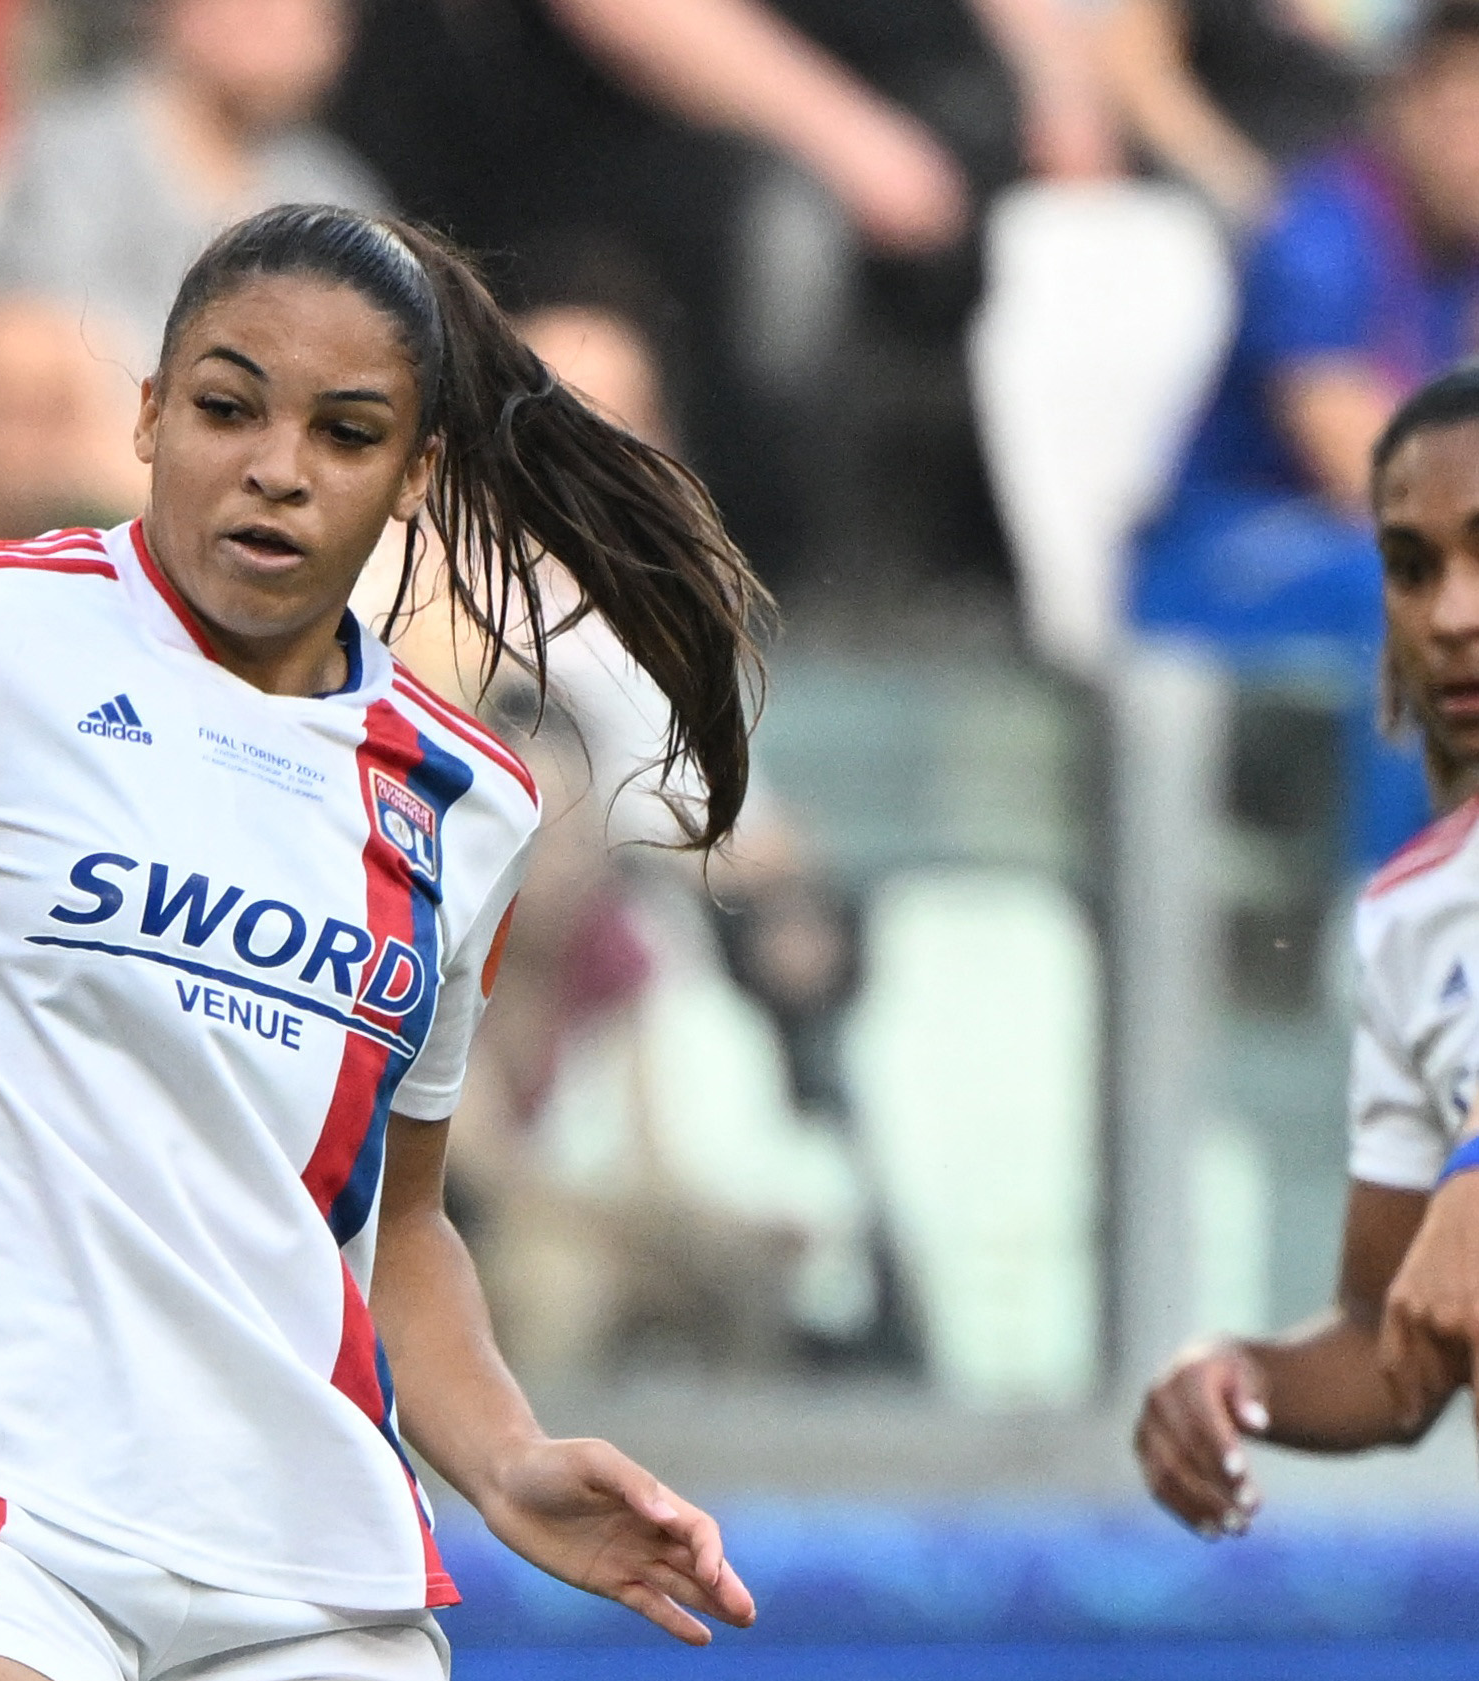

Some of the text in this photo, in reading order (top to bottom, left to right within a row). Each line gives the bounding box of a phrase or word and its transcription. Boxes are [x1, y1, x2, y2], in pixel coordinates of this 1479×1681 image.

[77, 720, 153, 746] adidas
[198, 727, 237, 750] FINAL
[241, 742, 292, 770] TORINO
[48, 852, 425, 1014] SWORD
[175, 979, 304, 1052] VENUE
